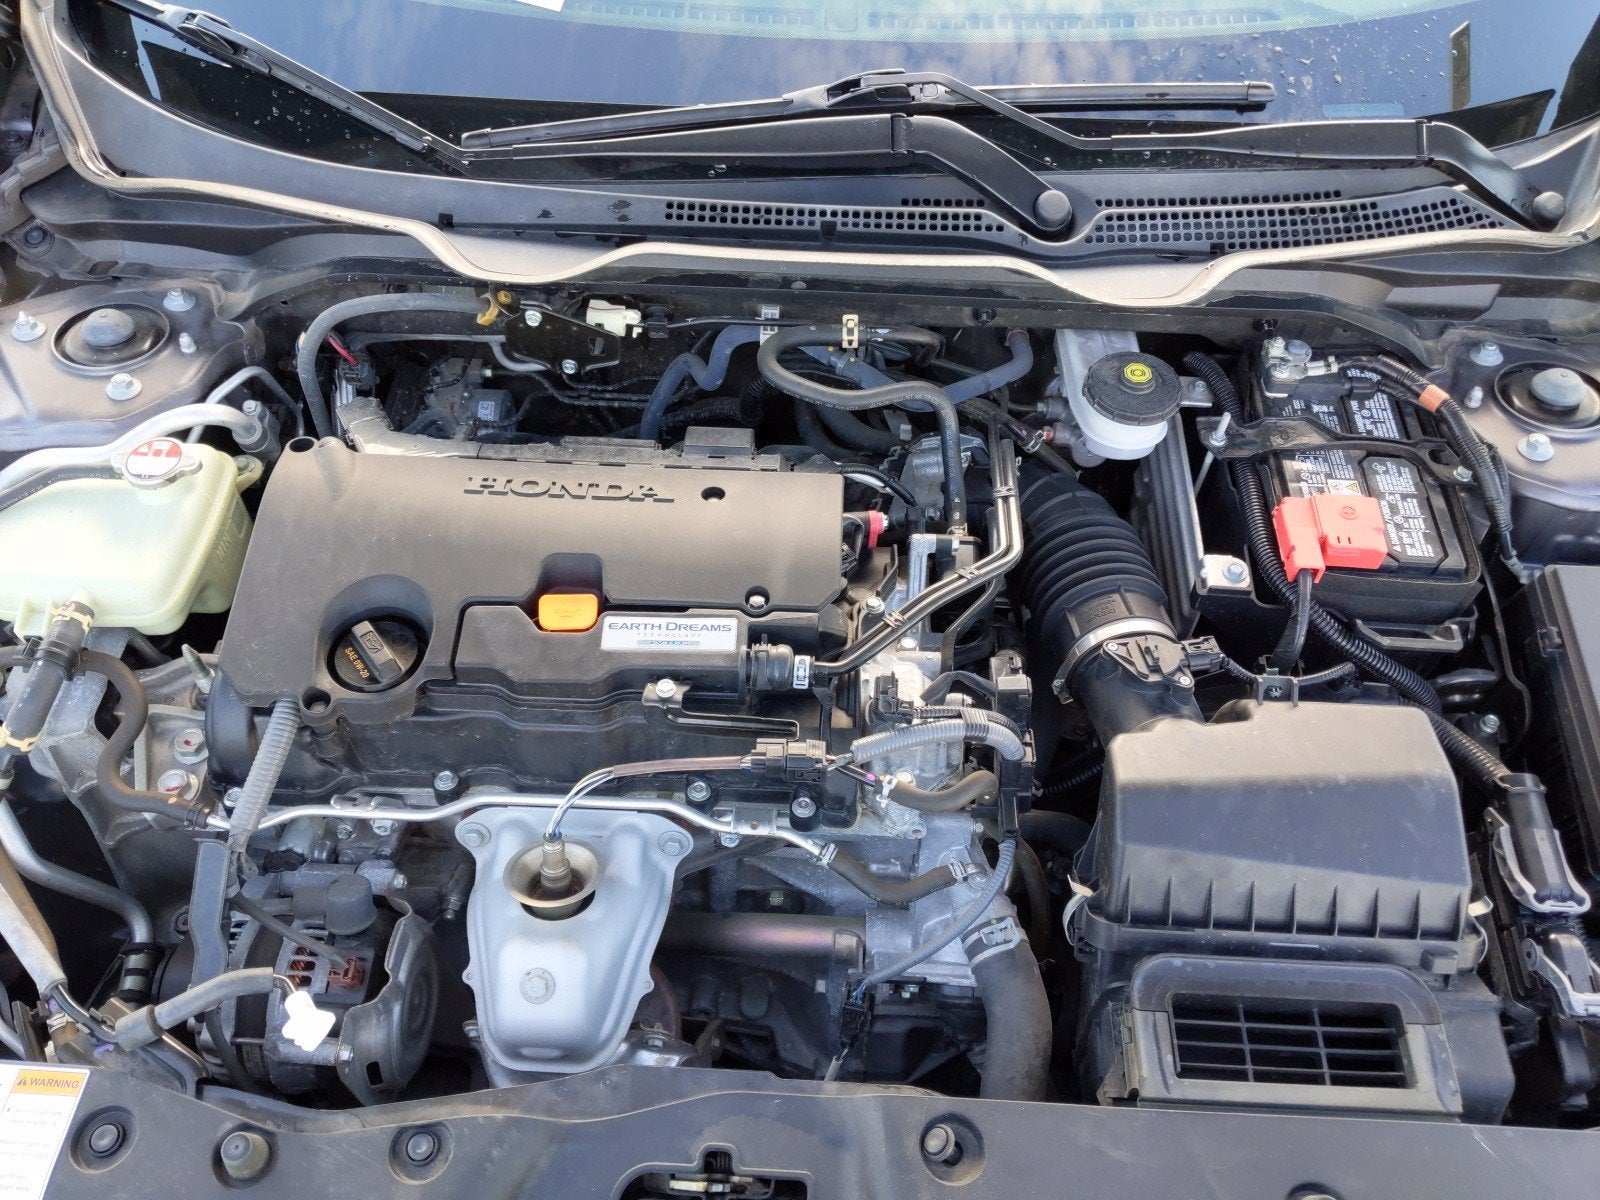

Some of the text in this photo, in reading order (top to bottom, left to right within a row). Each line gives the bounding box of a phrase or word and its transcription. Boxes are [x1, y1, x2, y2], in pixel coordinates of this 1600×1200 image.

[463, 476, 675, 503] HONDA
[608, 621, 732, 632] EARTH DREAMS
[345, 646, 370, 678] SAE 0W-20
[30, 1077, 79, 1089] WARNING
